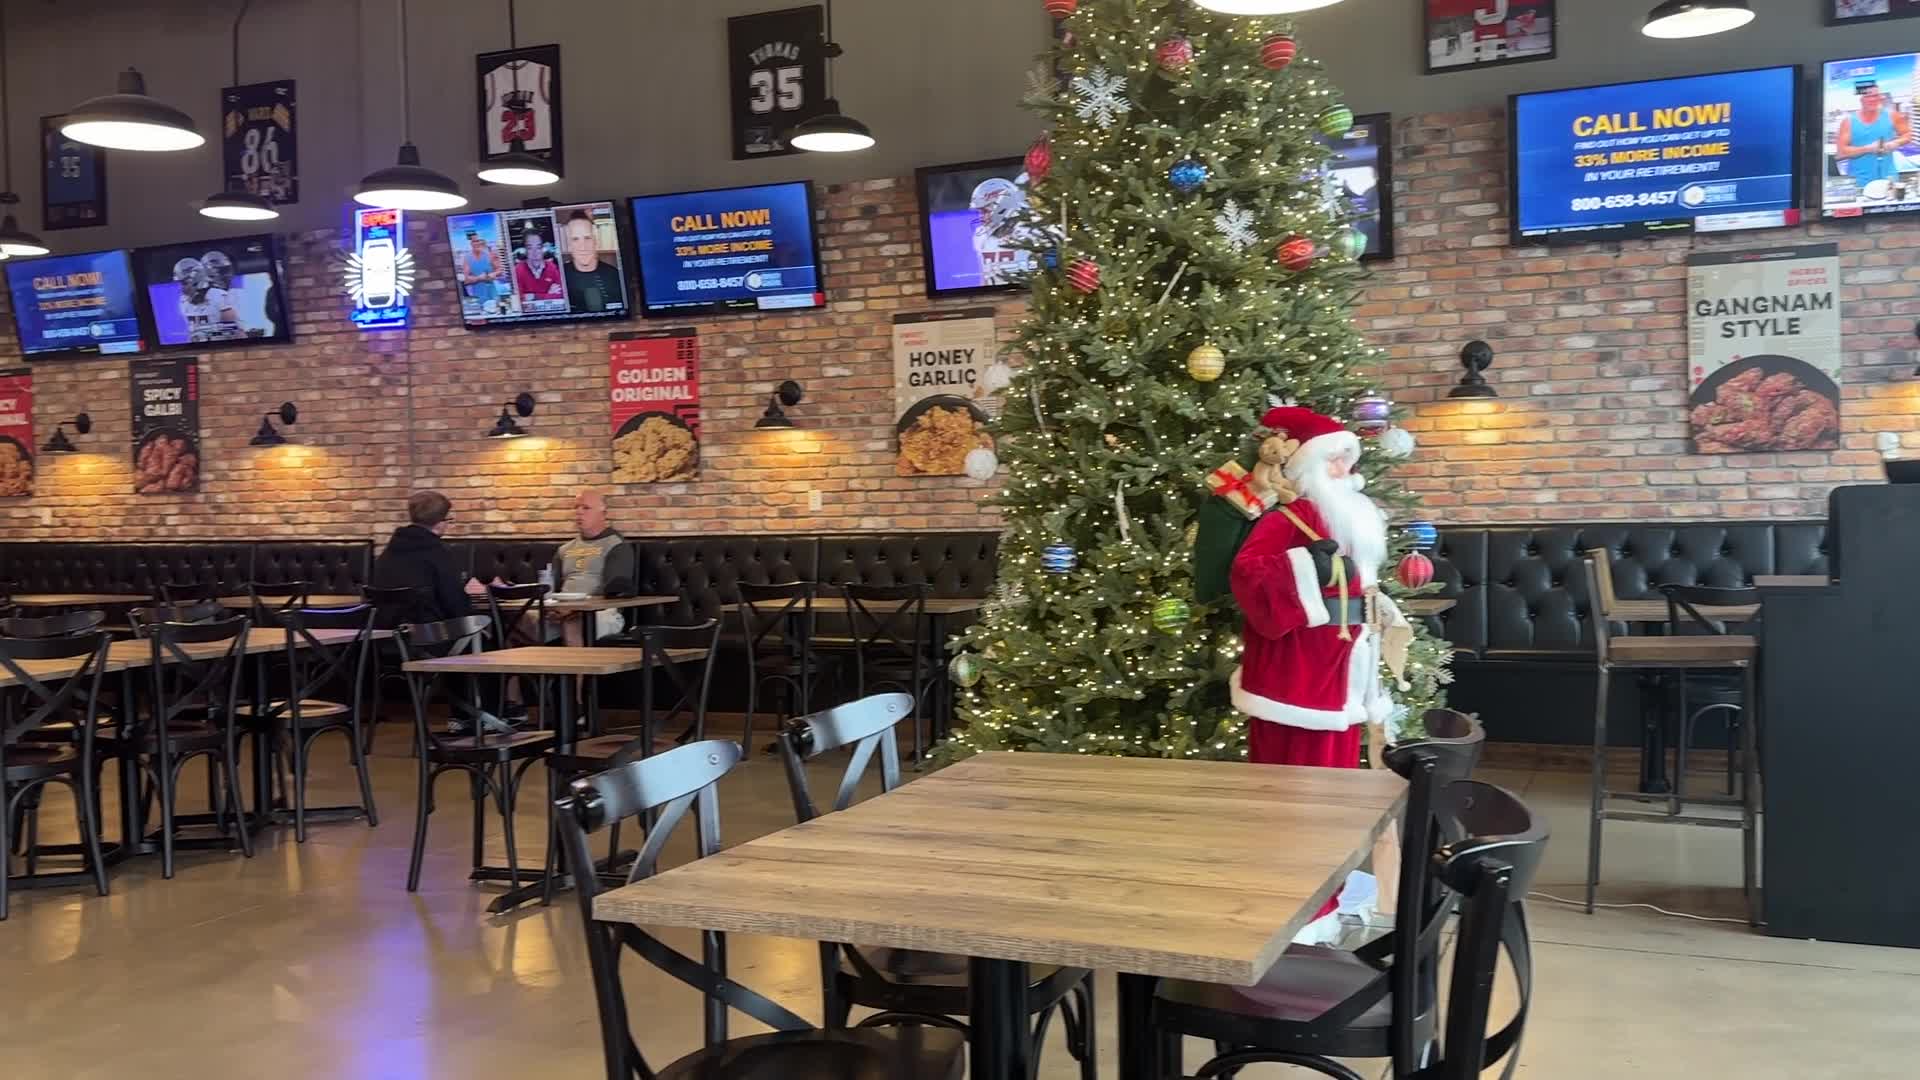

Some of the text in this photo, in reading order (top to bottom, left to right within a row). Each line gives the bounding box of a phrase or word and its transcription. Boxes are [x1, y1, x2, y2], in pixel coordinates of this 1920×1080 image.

[749, 66, 804, 113] 35
[1572, 102, 1731, 137] CALL NOW!
[241, 127, 279, 174] 86
[1574, 142, 1731, 167] 33% MORE INCOME
[1584, 161, 1720, 182] IN YOUR RETIREMENT!
[1571, 190, 1679, 211] 800-658-8457
[671, 208, 771, 233] CALL NOW!
[1695, 291, 1833, 317] GANGNAM
[1720, 317, 1801, 339] STYLE
[909, 348, 975, 367] HONEY
[616, 366, 687, 384] GOLDEN
[909, 368, 977, 387] GARLIC
[143, 387, 182, 401] SPICY
[611, 385, 694, 402] ORIGINAL
